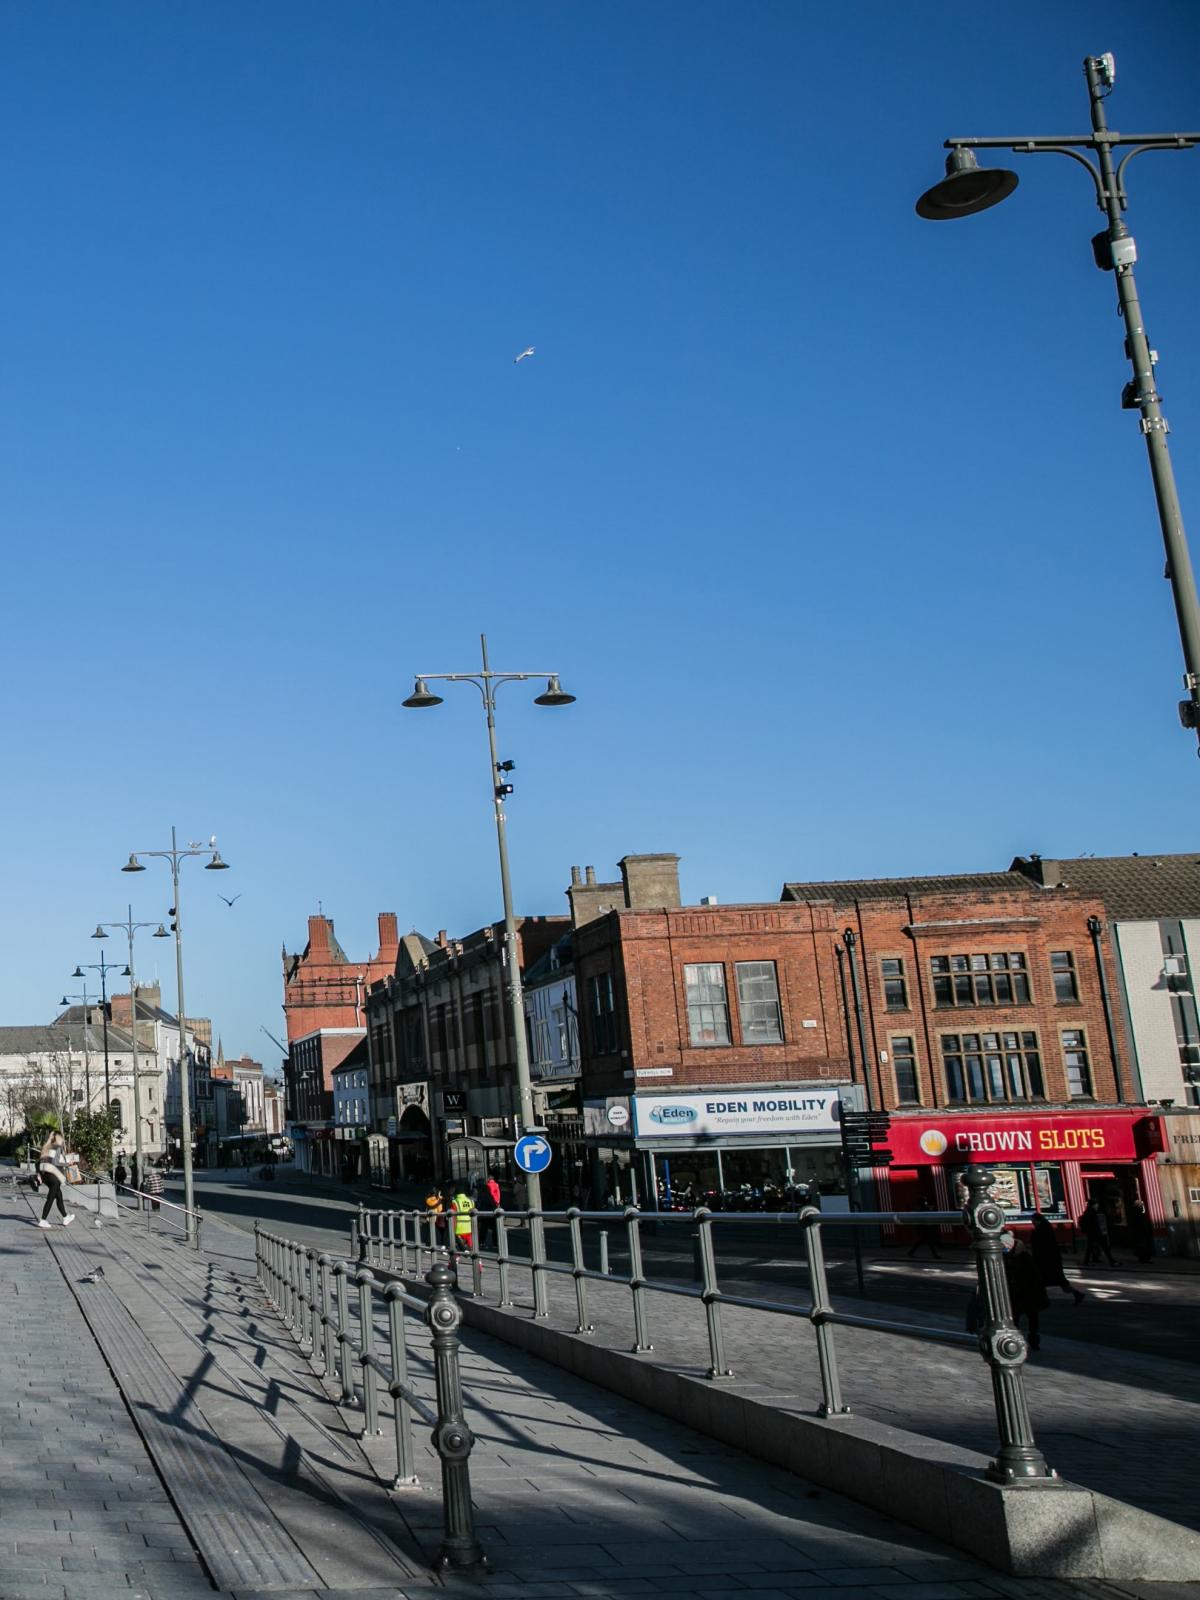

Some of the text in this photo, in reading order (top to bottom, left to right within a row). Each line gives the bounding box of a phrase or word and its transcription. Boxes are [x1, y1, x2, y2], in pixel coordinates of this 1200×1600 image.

[446, 1094, 461, 1105] W
[706, 1099, 826, 1113] EDEN MOBILITY
[662, 1108, 694, 1118] Eden
[756, 1114, 784, 1123] freedom
[955, 1129, 1105, 1151] CROWN SLOTS
[1174, 1135, 1200, 1144] FRE
